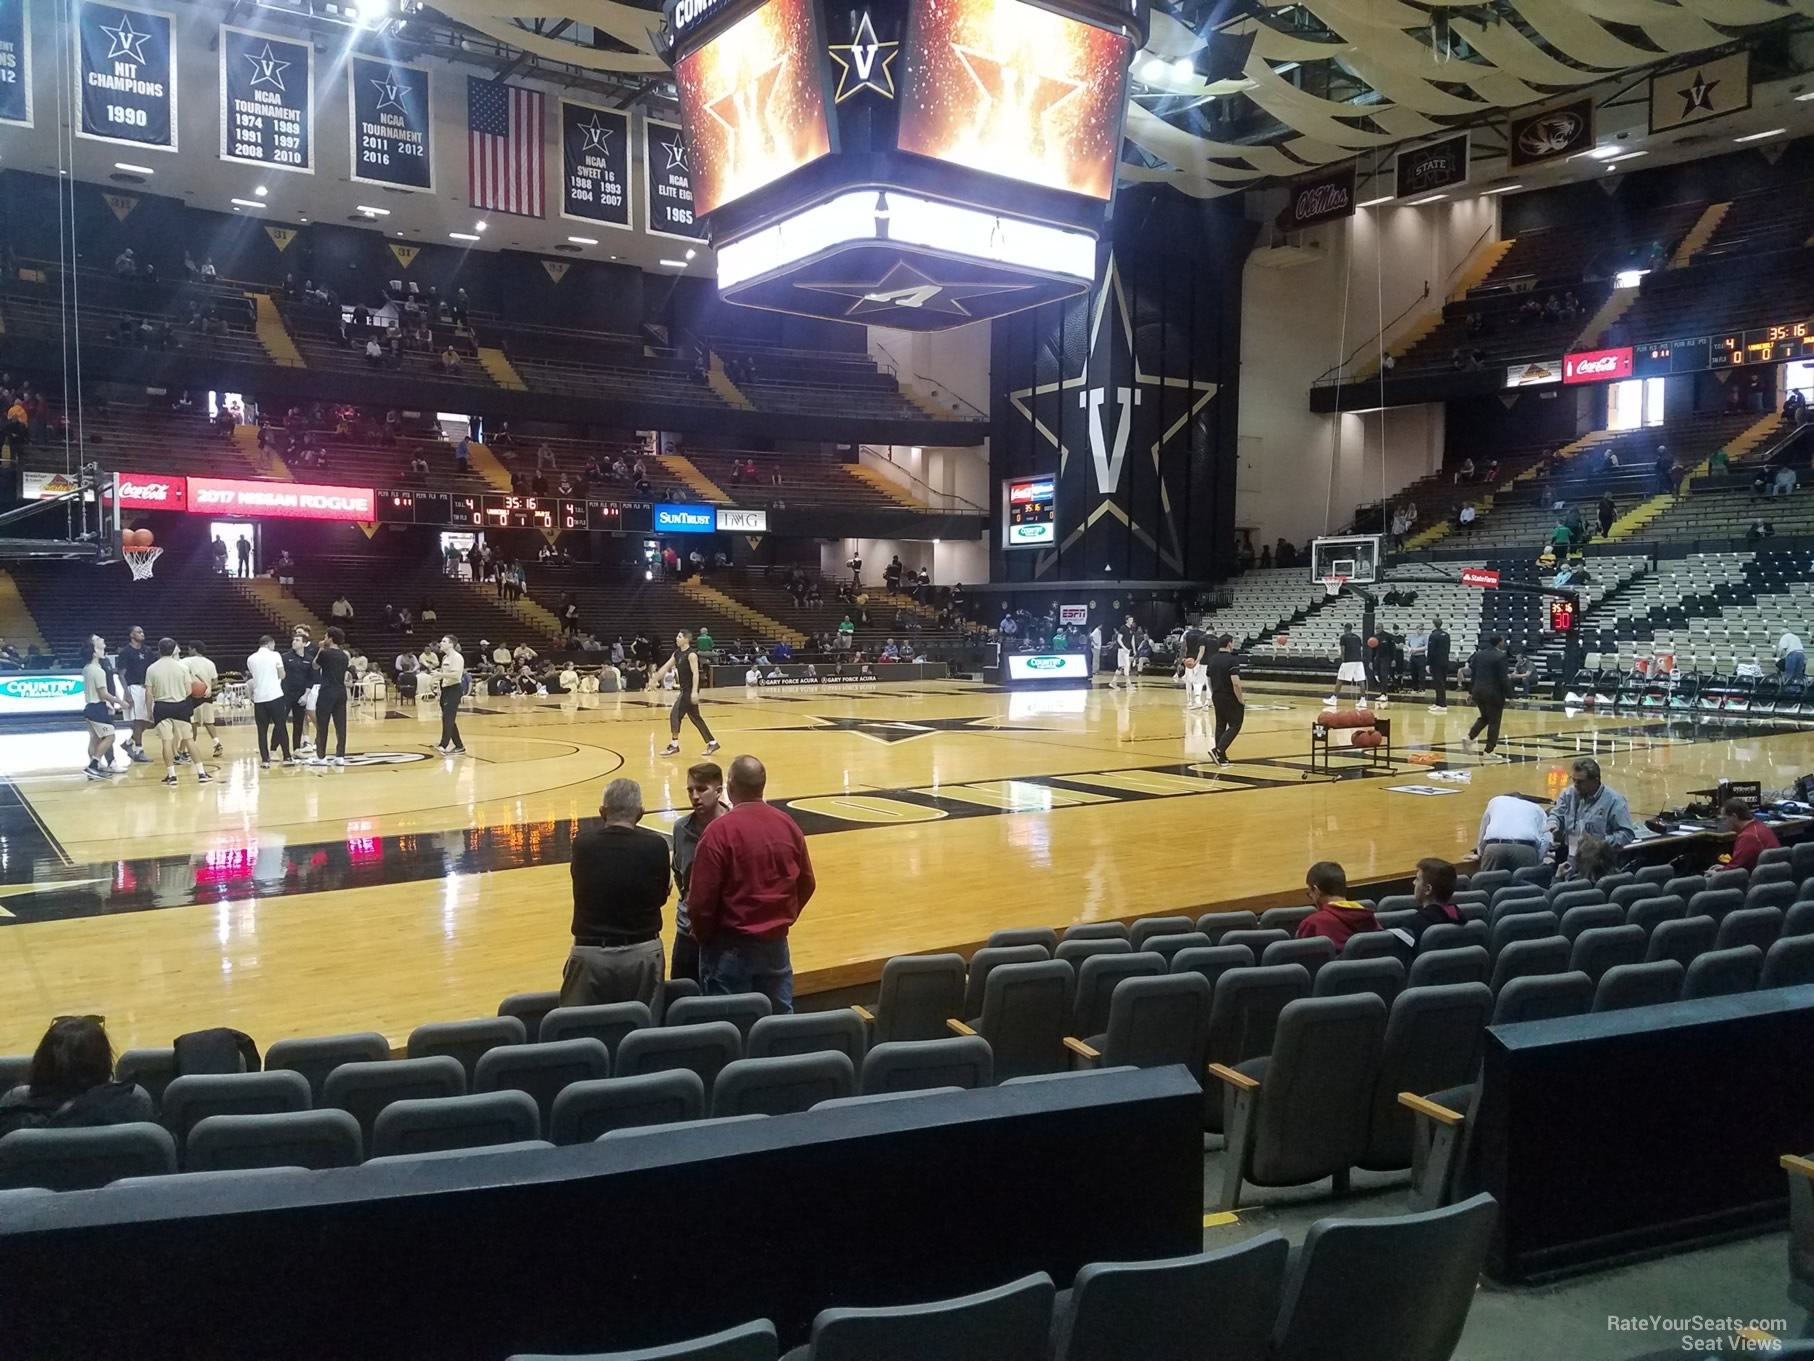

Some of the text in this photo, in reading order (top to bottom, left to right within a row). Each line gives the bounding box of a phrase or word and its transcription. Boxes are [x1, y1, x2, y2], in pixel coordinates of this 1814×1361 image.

[676, 0, 717, 29] COM
[115, 61, 137, 78] NIT
[851, 45, 878, 80] V
[89, 72, 163, 97] CHAMPIONS
[254, 90, 282, 105] NCAA
[1690, 84, 1705, 106] V
[107, 105, 147, 127] 1990
[235, 99, 301, 121] TOURNAMENT
[236, 113, 300, 135] 1974 1989
[380, 113, 404, 127] NCAA
[236, 128, 300, 149] 1991 1997
[362, 122, 422, 143] TOURNAMENT
[235, 143, 302, 164] 2008 2010
[362, 136, 424, 157] 2011 2012
[363, 150, 390, 165] 2016
[585, 155, 606, 169] NCAA
[577, 165, 615, 182] SWEET 16
[1416, 160, 1446, 176] STATE
[571, 176, 621, 194] 1988 1993
[669, 174, 688, 188] NCAA
[571, 188, 622, 207] 2004 2007
[658, 185, 693, 201] ELITE EIG
[666, 206, 693, 224] 1965
[1770, 324, 1805, 340] 35:16
[1726, 339, 1734, 349] 4
[1786, 347, 1791, 356] 1
[1733, 351, 1742, 363] 0
[1762, 348, 1770, 360] 0
[1079, 387, 1141, 494] V
[119, 482, 169, 500] Coca-Cola
[197, 489, 368, 511] 2017 NISSAN ROGUE
[465, 499, 473, 510] 4
[505, 496, 536, 509] 35:16
[566, 503, 574, 514] 4
[473, 512, 481, 524] 0
[500, 515, 507, 526] 0
[521, 517, 525, 526] 1
[544, 516, 551, 527] 0
[566, 516, 574, 528] 0
[724, 513, 758, 527] IMG
[1063, 609, 1085, 618] ESPN
[1551, 603, 1573, 613] 35:16
[1555, 613, 1570, 629] 30
[7, 680, 76, 693] COUNTRY
